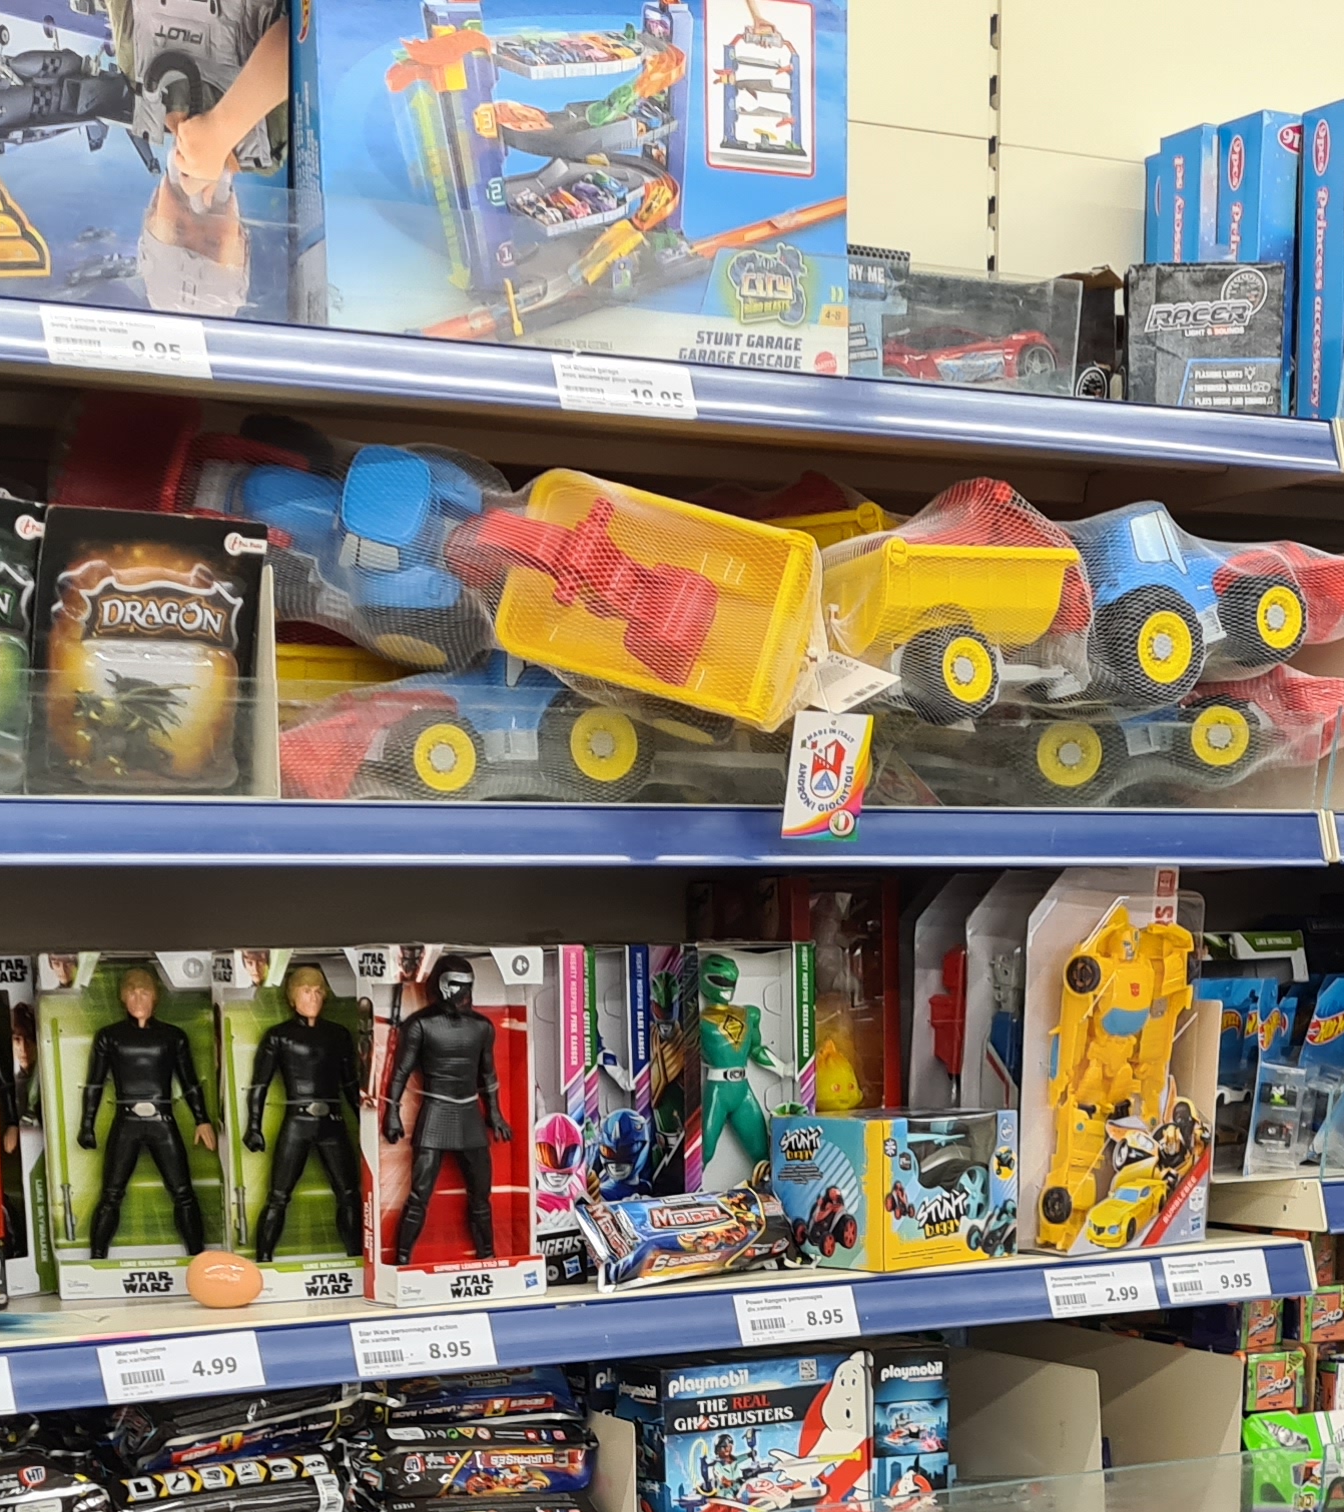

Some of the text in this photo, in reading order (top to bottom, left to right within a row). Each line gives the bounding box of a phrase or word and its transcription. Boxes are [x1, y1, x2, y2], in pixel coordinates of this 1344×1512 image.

[155, 23, 203, 46] PILOT
[867, 264, 885, 282] ME
[1150, 302, 1252, 330] RACER
[696, 330, 802, 352] STUNT GARAGE
[1185, 327, 1205, 337] LIGHT
[131, 339, 182, 362] 9.95
[678, 347, 802, 370] GARAGE CASCADE
[101, 598, 224, 634] DRAGON
[359, 953, 386, 965] STAR
[358, 965, 386, 978] WARS
[916, 1188, 970, 1227] STUNT
[1163, 1175, 1197, 1224] BUMBLEBEE
[122, 1271, 174, 1282] STAR
[304, 1273, 353, 1286] STAR
[450, 1274, 493, 1287] STAR
[1219, 1272, 1253, 1290] 9.95
[123, 1282, 174, 1294] WARS
[305, 1284, 353, 1297] WARS
[451, 1285, 493, 1298] WARS
[1105, 1286, 1139, 1303] 2.99
[806, 1308, 843, 1326] 8.95
[427, 1340, 472, 1360] 8.95
[192, 1357, 238, 1378] 4.99
[880, 1361, 943, 1382] playmobil
[668, 1369, 750, 1398] playmobil
[697, 1394, 771, 1414] THE REAL
[673, 1406, 794, 1432] GHOSTBUSTERS
